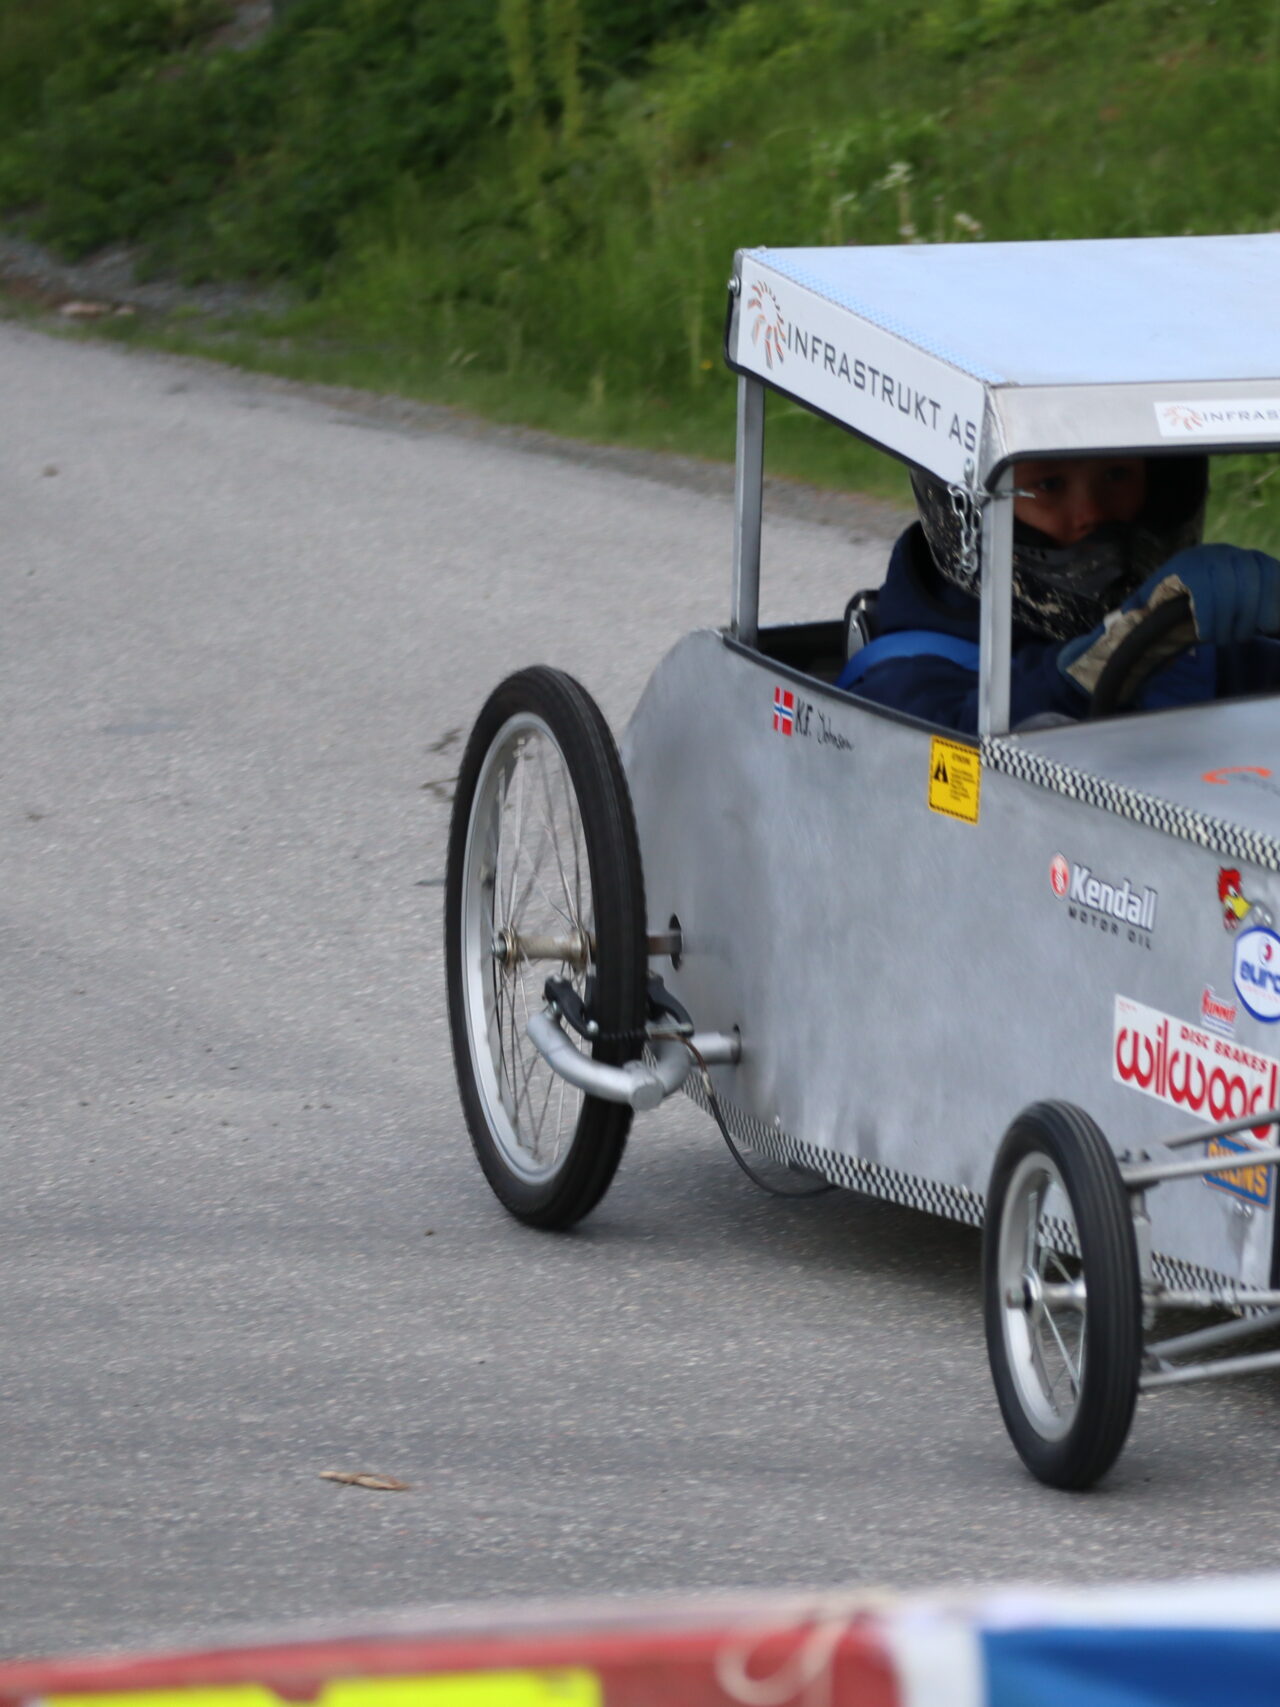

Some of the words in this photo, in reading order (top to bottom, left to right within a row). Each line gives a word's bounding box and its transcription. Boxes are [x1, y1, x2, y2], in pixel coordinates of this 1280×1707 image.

[787, 321, 941, 431] INFRASTRUKT
[948, 412, 977, 453] AS
[1069, 862, 1158, 933] Kendall
[1068, 905, 1119, 936] MOTOR
[1127, 929, 1152, 951] OIL
[1180, 1025, 1211, 1050] DISC
[1213, 1038, 1269, 1074] BRAKES
